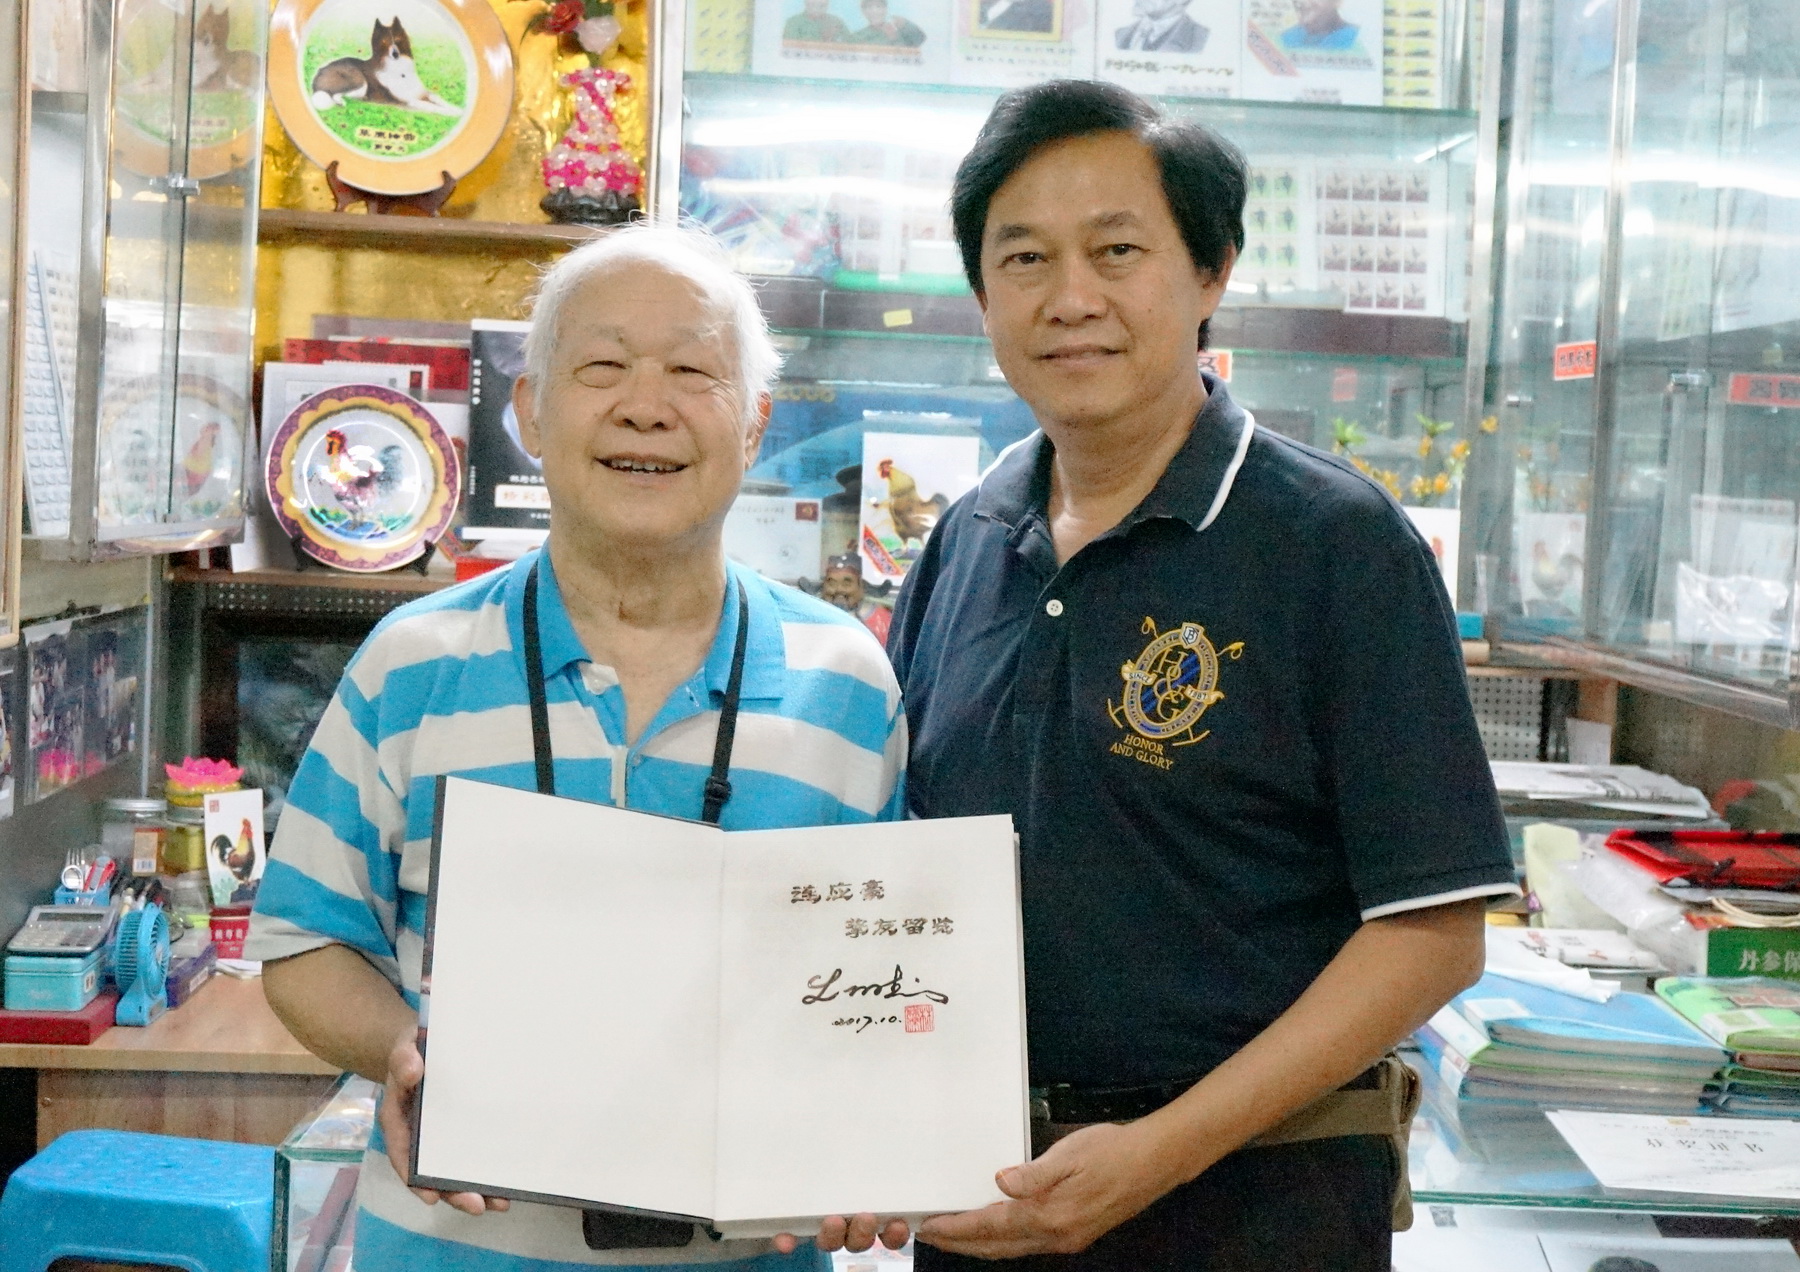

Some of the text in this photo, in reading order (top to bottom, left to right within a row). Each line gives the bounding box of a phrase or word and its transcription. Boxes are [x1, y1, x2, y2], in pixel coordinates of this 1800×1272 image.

[1110, 742, 1175, 771] AND GLORY
[1123, 734, 1165, 756] HONOR
